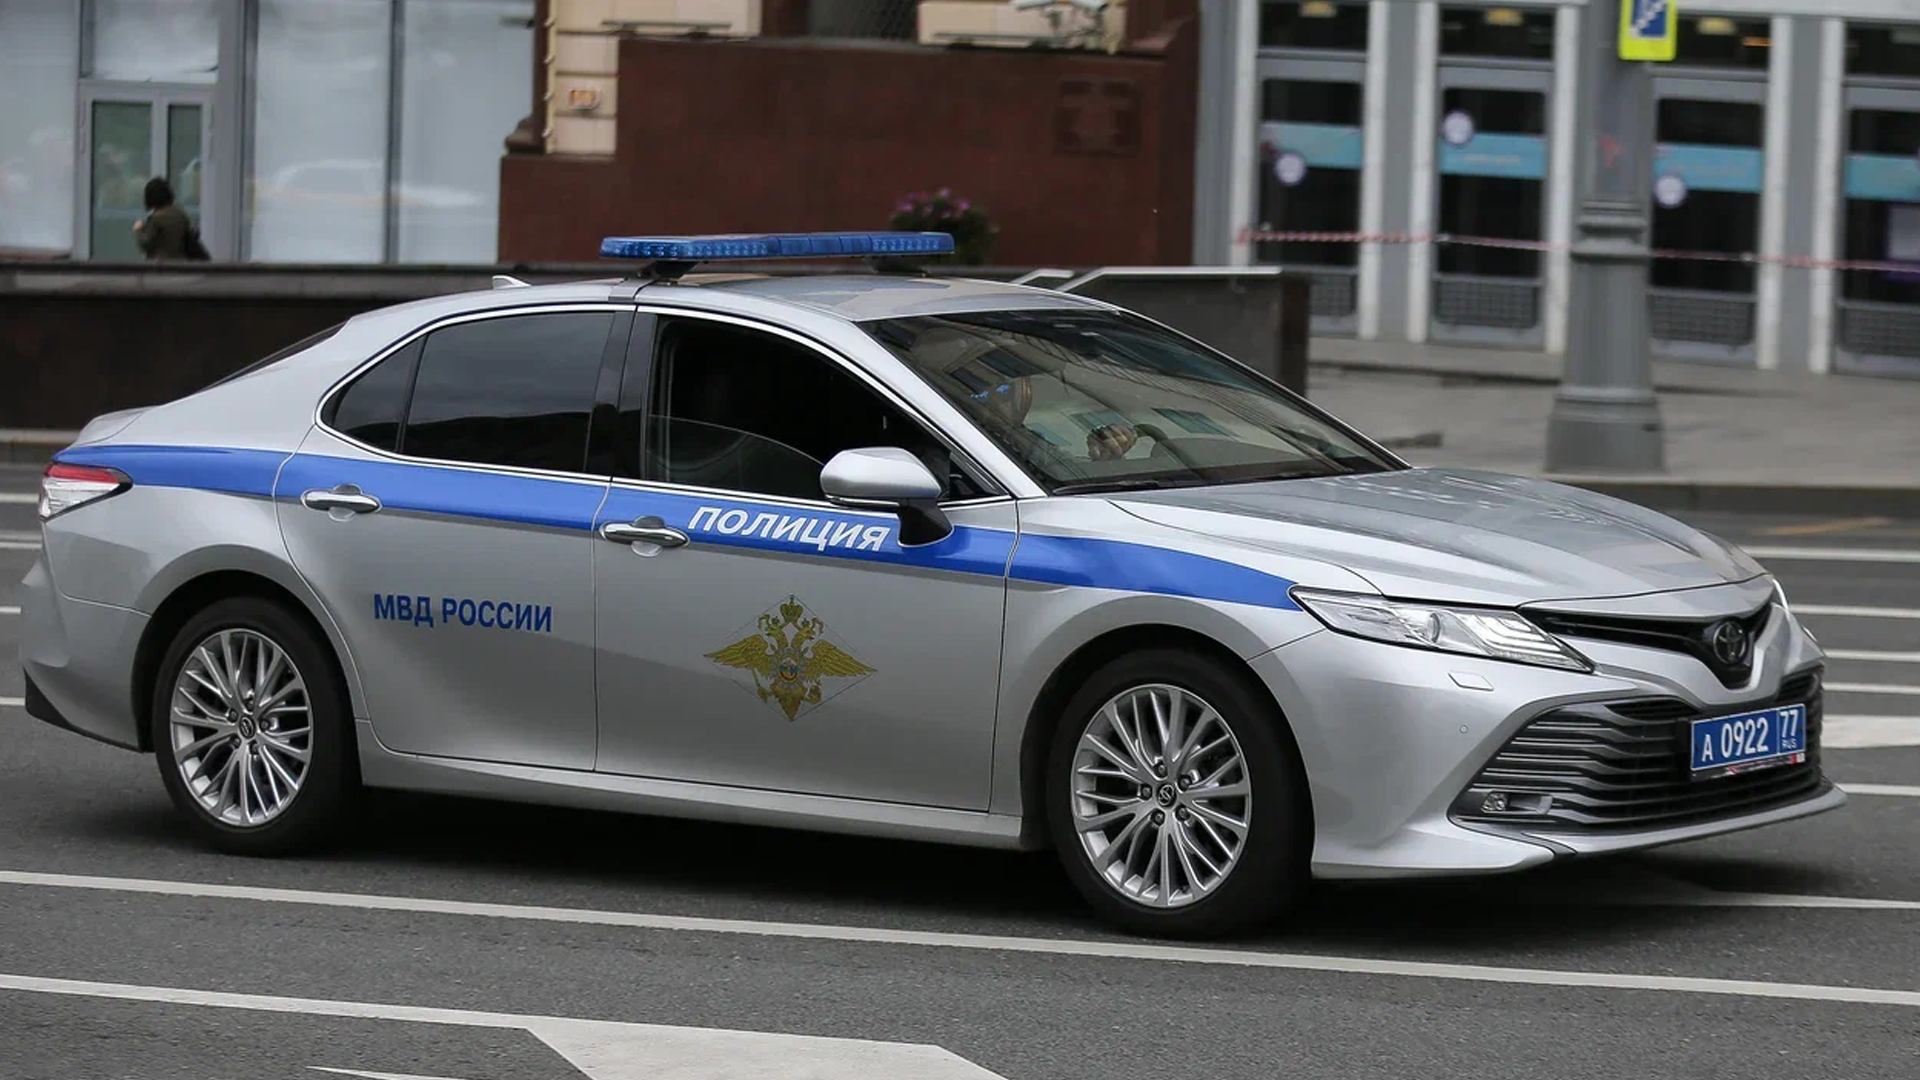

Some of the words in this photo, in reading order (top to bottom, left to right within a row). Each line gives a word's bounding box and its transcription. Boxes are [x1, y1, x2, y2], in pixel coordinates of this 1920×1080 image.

[687, 506, 891, 552] ПОЛИЦИЯ
[374, 593, 434, 628] МВД
[441, 598, 553, 633] РОССИИ
[1701, 734, 1714, 762] А
[1720, 716, 1770, 759] 0922
[1780, 708, 1799, 739] 77
[1781, 738, 1798, 750] RUS
